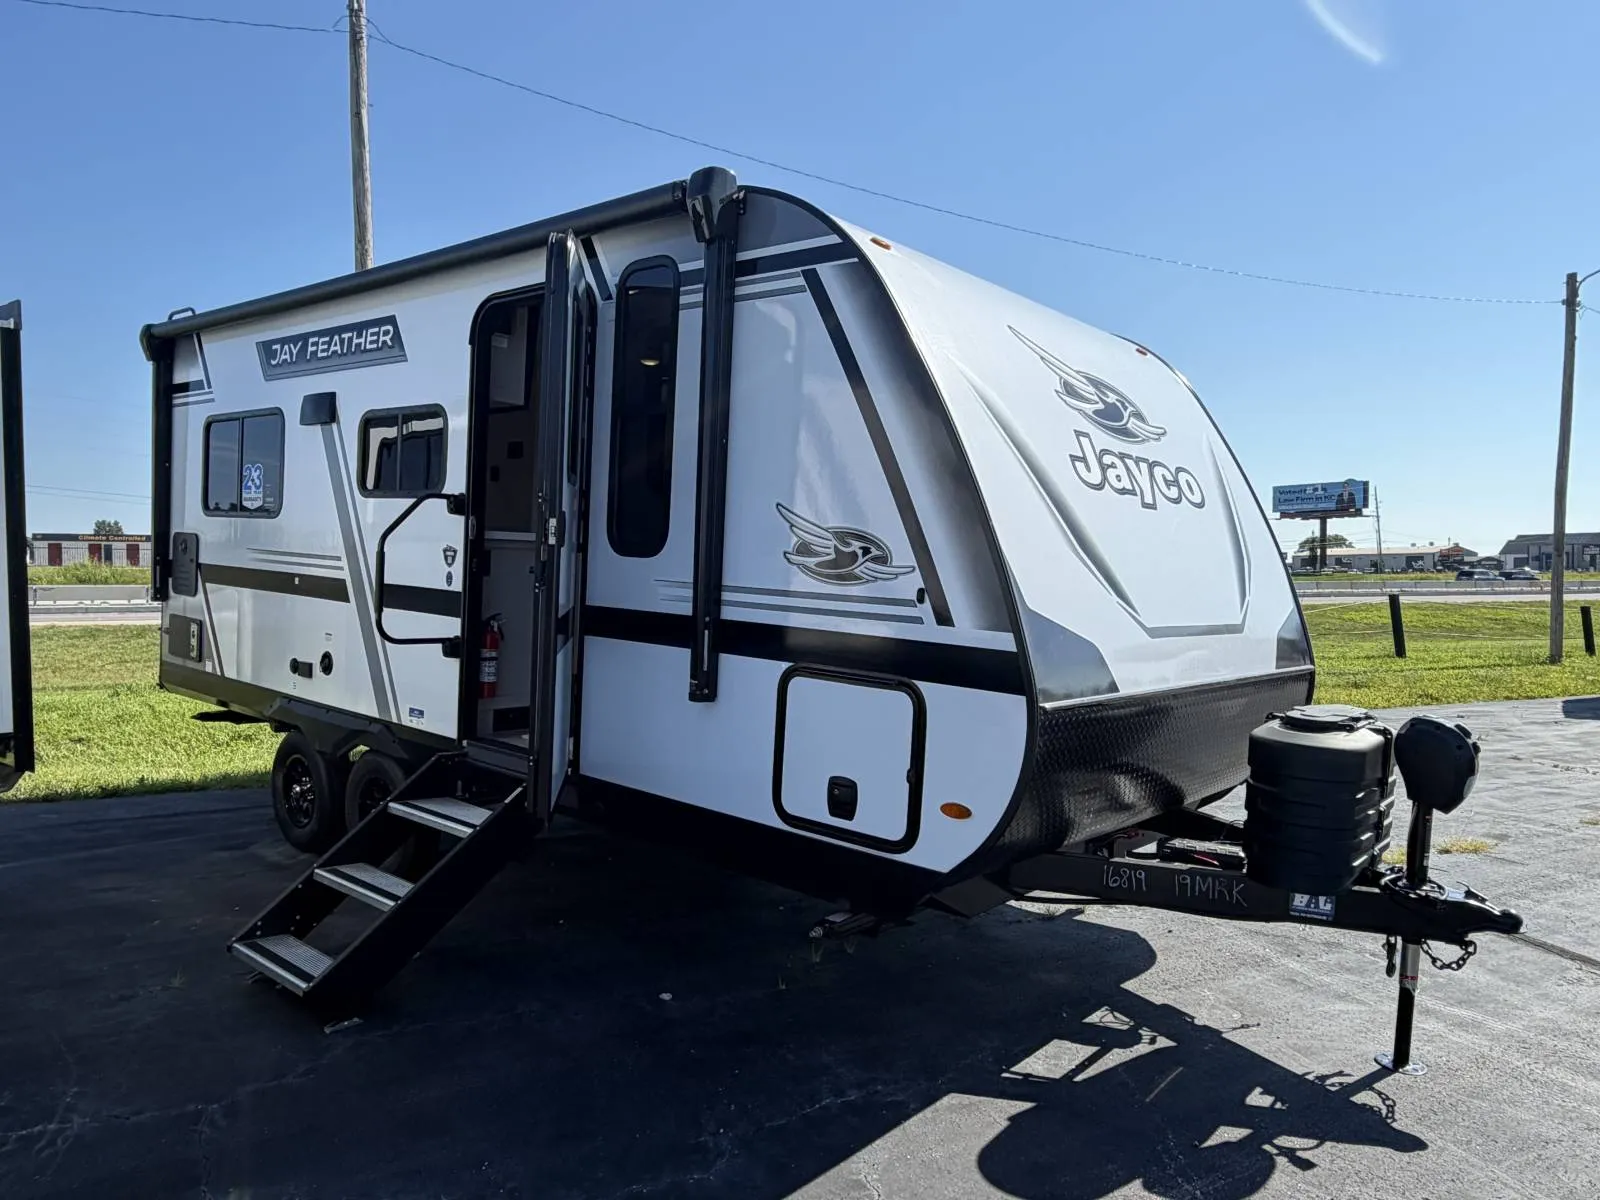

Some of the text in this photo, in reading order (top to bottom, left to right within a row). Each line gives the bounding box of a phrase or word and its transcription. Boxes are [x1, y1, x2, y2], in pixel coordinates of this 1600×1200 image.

[270, 325, 394, 366] JAY FEATHER
[1068, 429, 1205, 510] Jayco
[1295, 496, 1314, 504] Firm
[1103, 864, 1248, 908] 16819 19MRK
